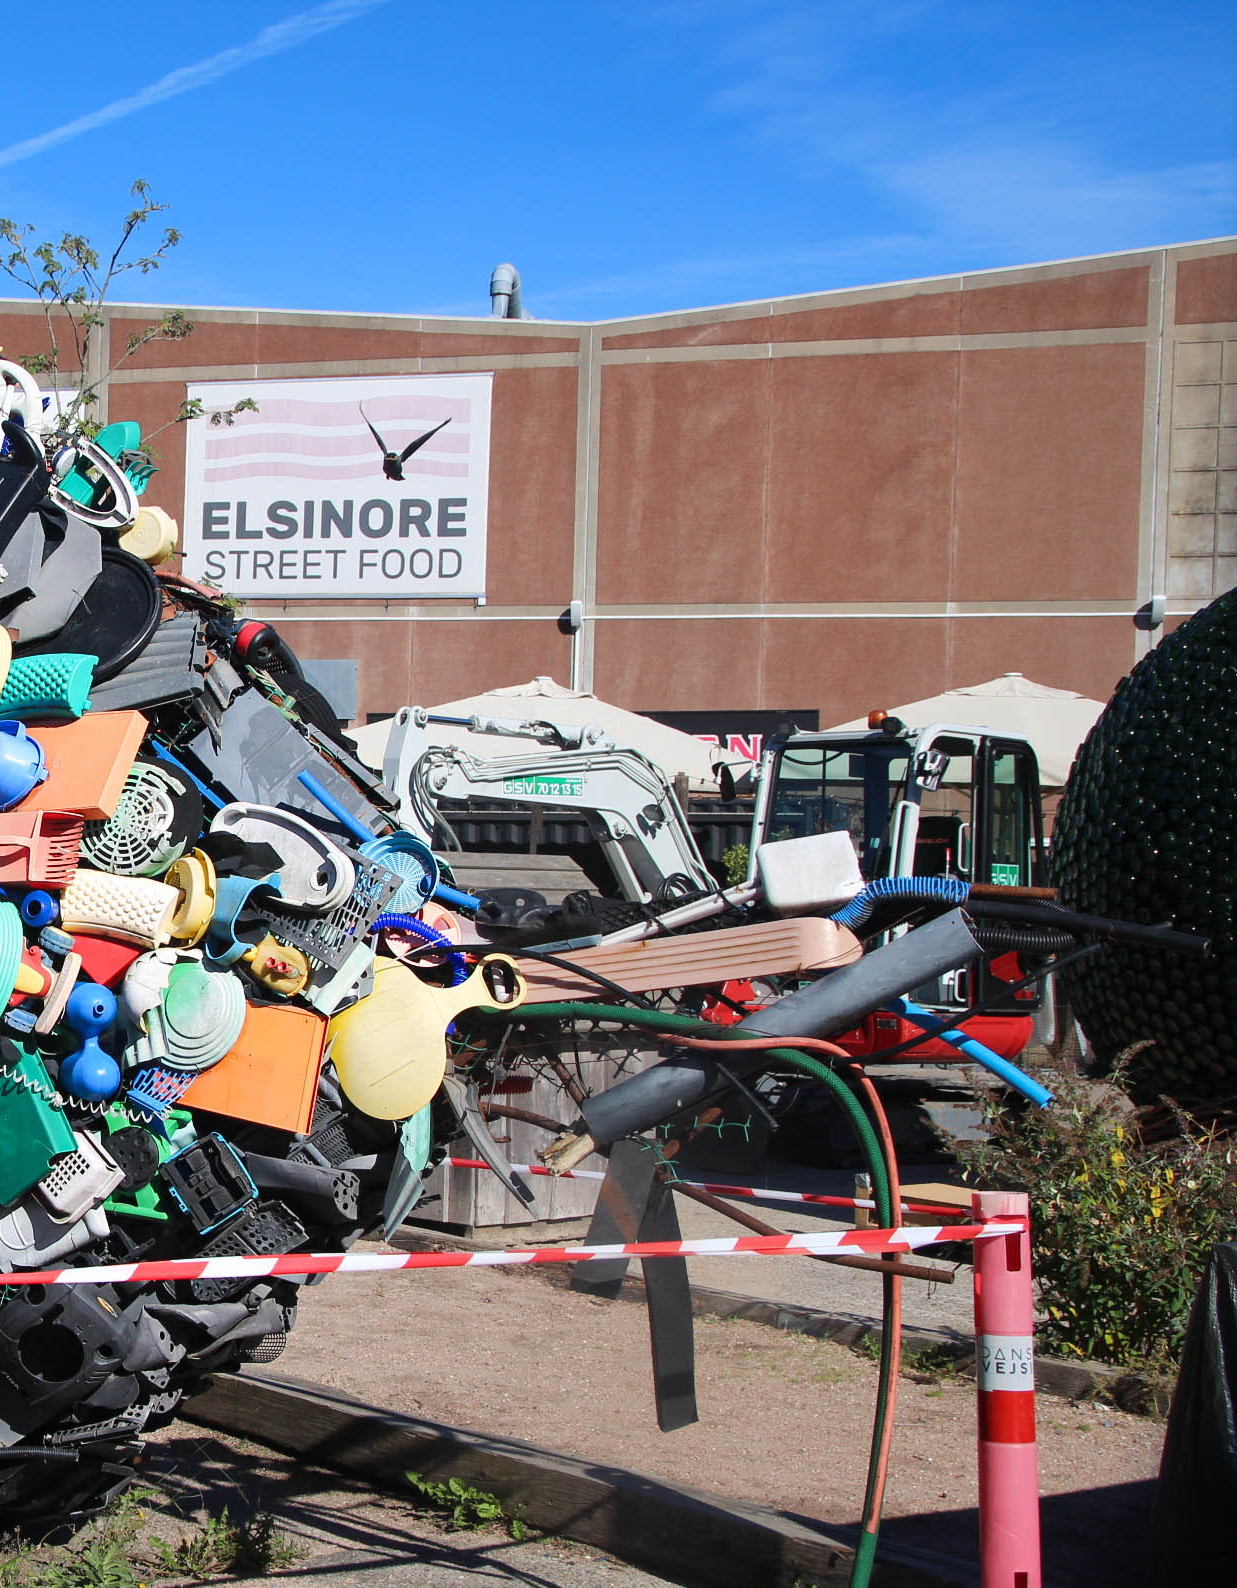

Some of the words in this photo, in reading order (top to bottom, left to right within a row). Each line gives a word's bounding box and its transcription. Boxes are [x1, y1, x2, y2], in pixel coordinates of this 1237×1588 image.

[202, 497, 468, 540] ELSINORE
[204, 549, 347, 580] STREET
[358, 548, 463, 579] FOOD
[504, 781, 533, 794] GSV
